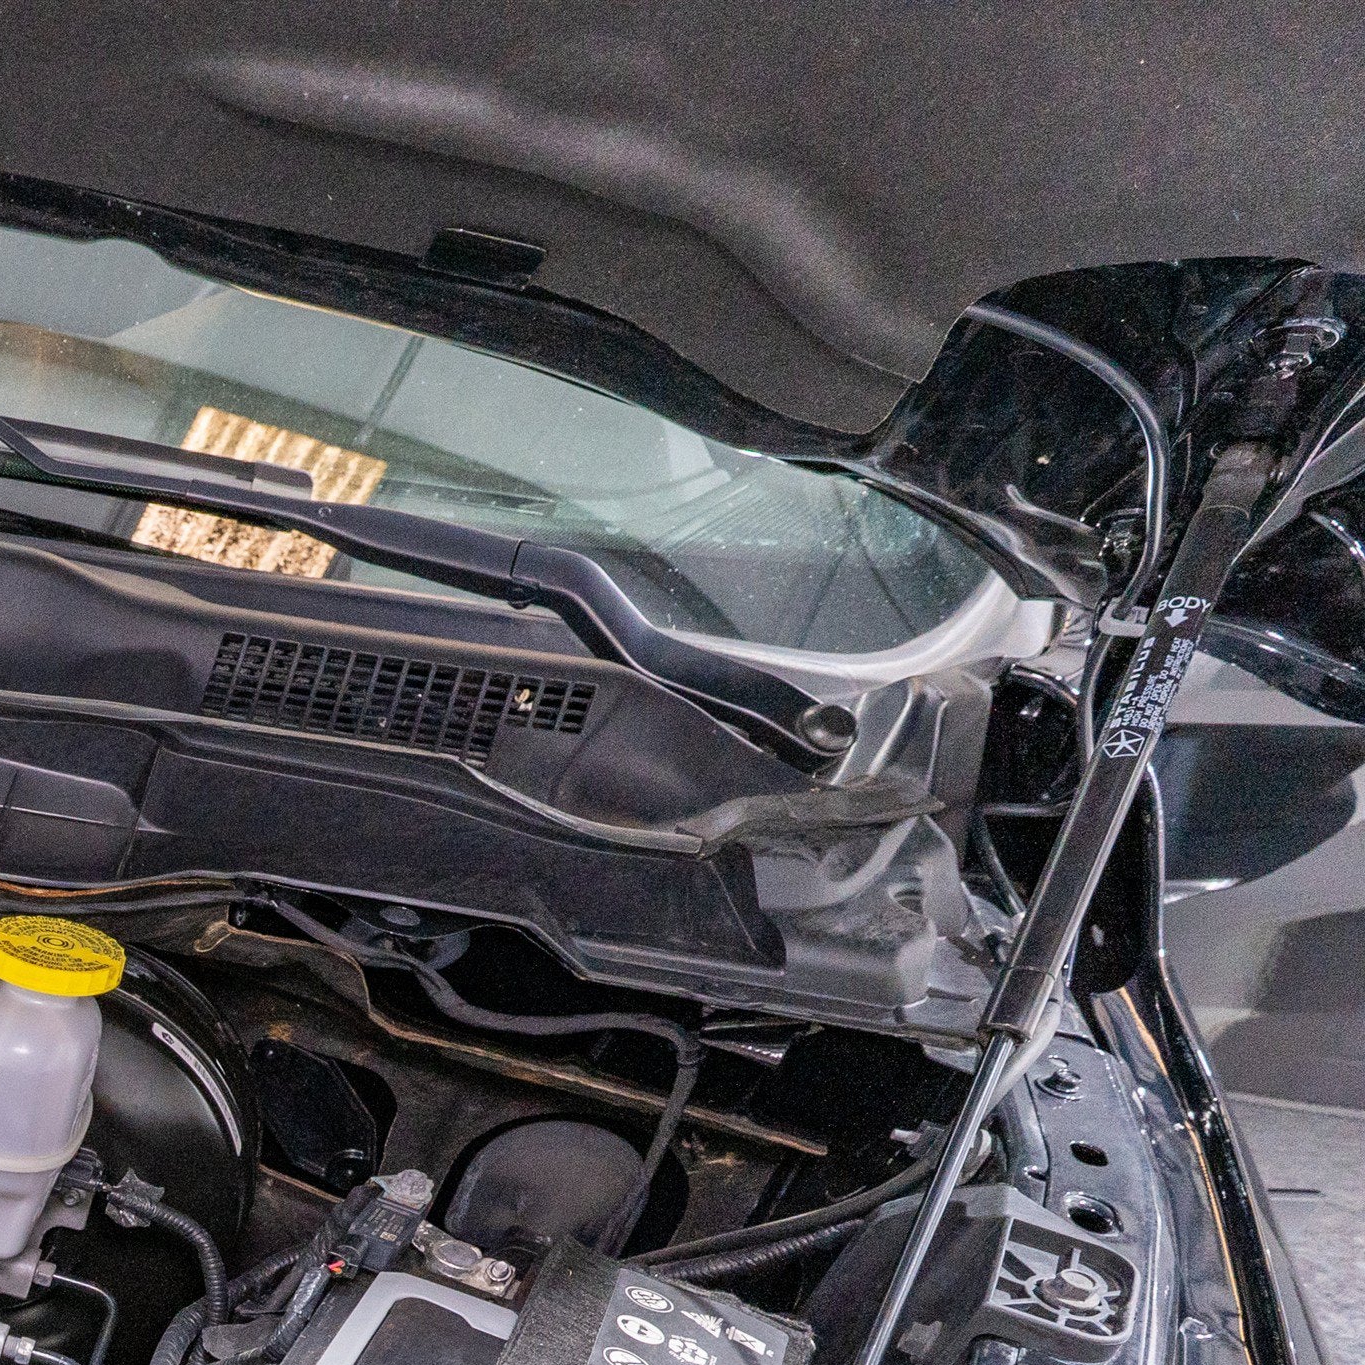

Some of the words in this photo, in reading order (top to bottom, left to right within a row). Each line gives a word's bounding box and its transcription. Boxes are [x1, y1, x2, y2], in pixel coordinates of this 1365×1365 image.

[1156, 596, 1211, 614] BODY
[1163, 654, 1175, 668] NOT
[1110, 636, 1156, 729] STABILUS
